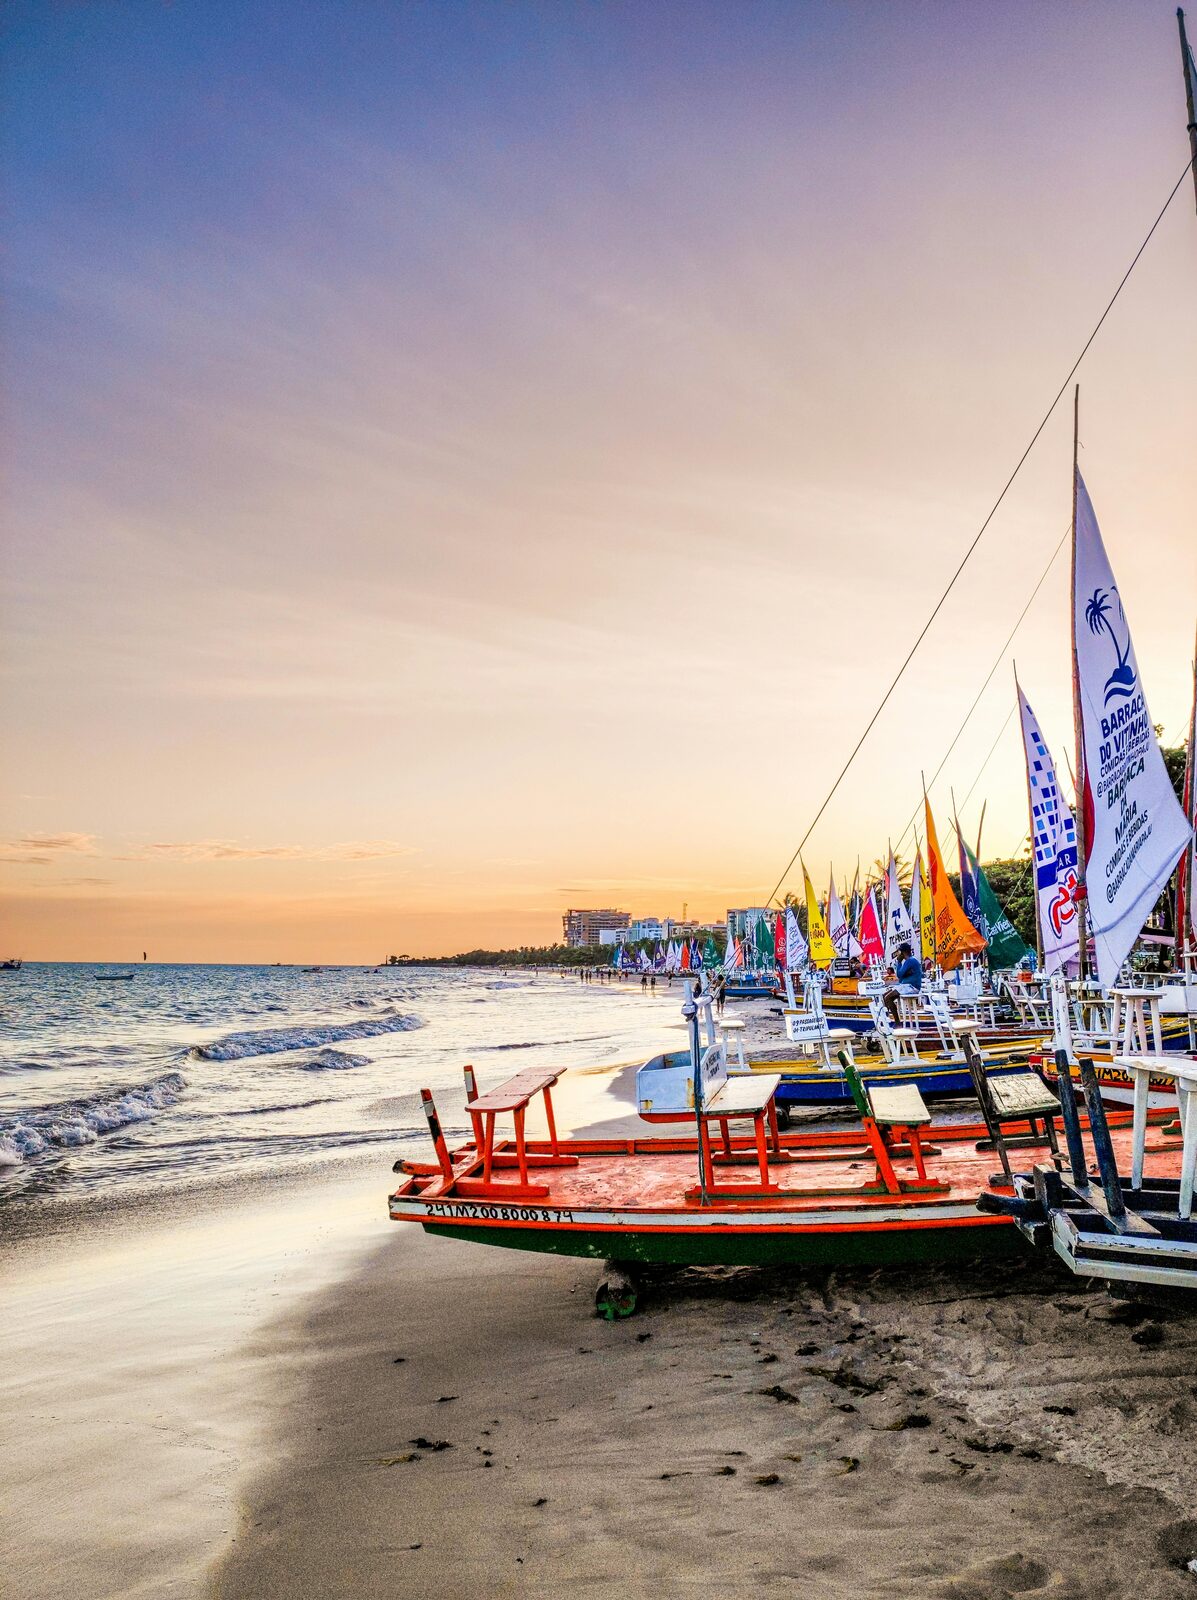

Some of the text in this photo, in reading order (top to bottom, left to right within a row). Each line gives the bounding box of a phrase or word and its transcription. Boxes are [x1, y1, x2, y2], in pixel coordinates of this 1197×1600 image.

[1099, 742, 1111, 765] DO
[1100, 749, 1126, 778] COMIDAS
[1115, 800, 1137, 844] MARIA
[425, 1203, 574, 1223] 241M2008000874
